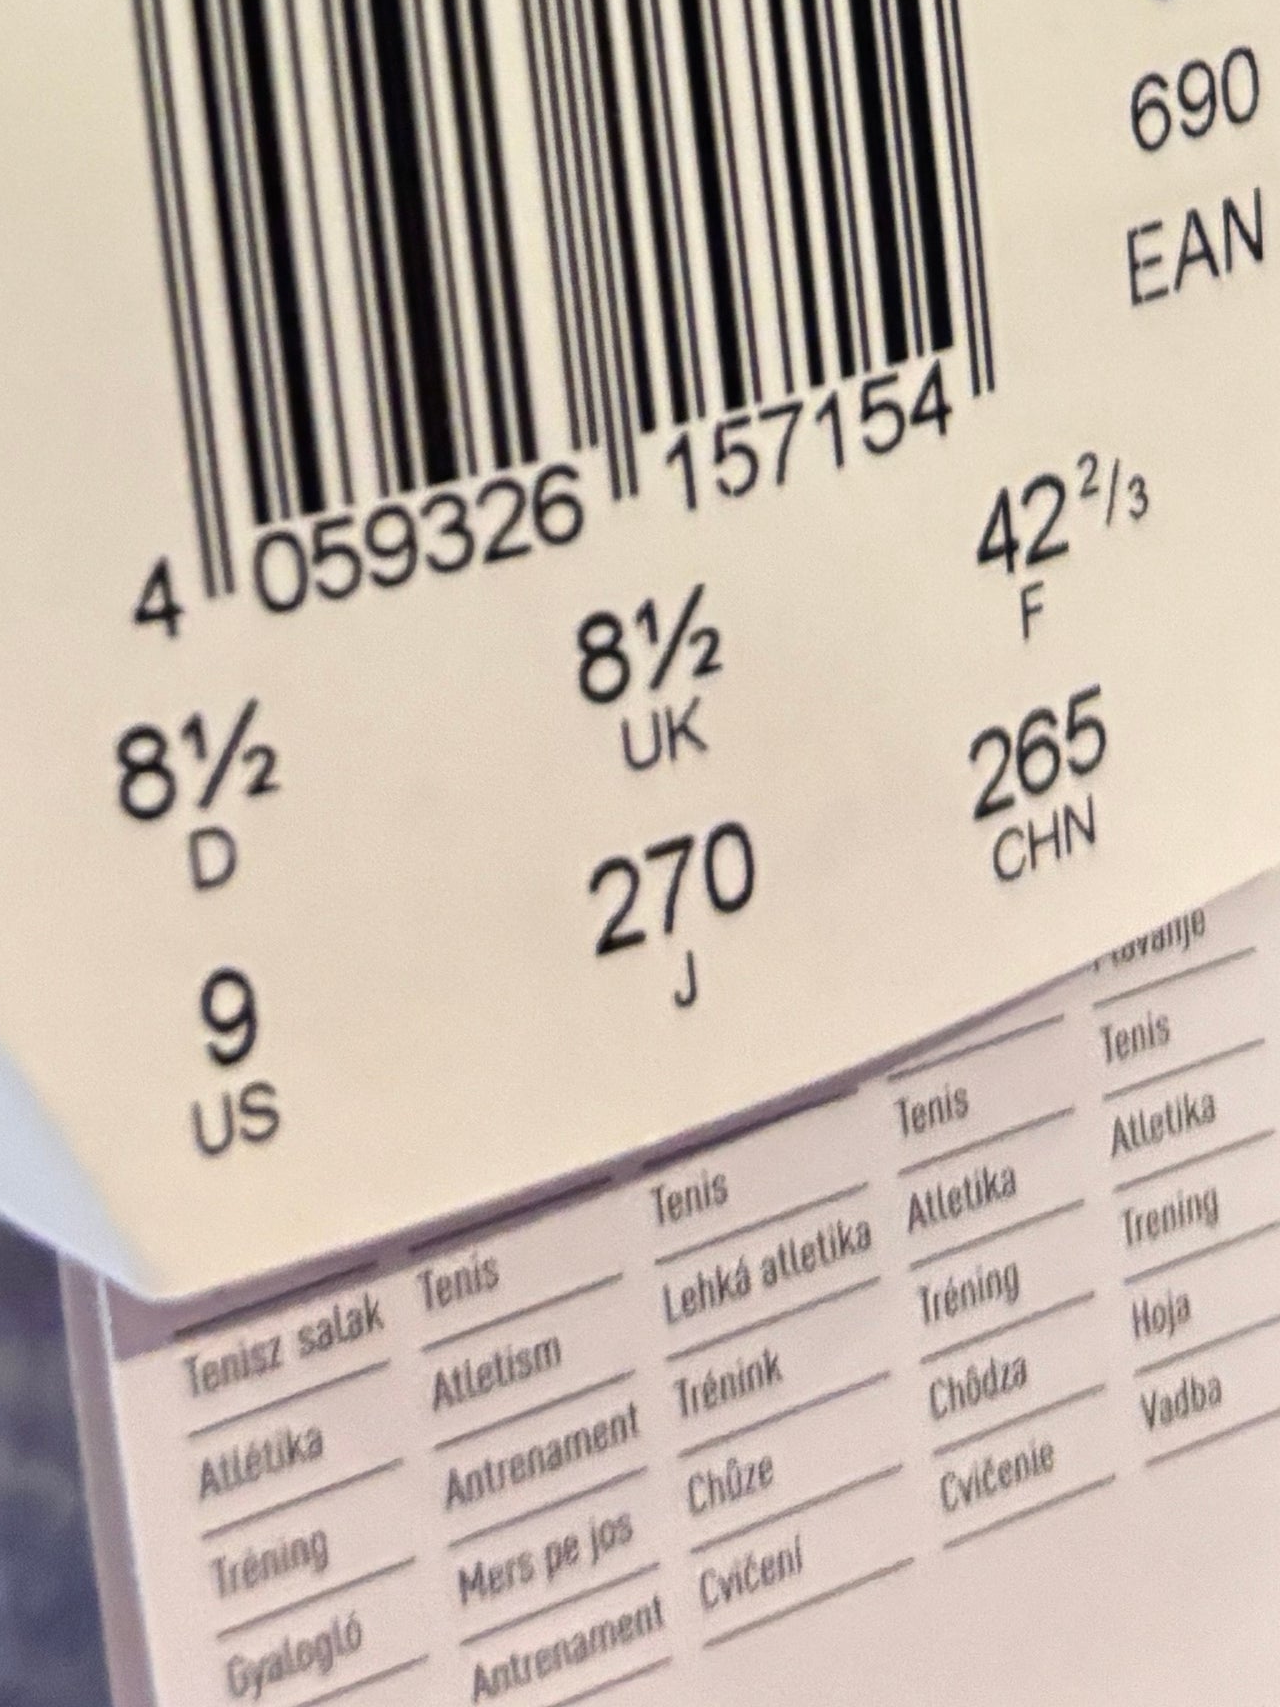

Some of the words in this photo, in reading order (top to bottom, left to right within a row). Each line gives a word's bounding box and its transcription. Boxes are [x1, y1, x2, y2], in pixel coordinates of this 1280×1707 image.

[1129, 46, 1261, 154] 690
[1126, 186, 1265, 307] EAN
[133, 558, 184, 638] 4
[251, 463, 586, 616] 059326
[664, 359, 953, 511] 157154
[1019, 580, 1045, 641] F
[620, 696, 709, 773] UK
[968, 683, 1108, 822] 265
[188, 825, 238, 893] D
[992, 791, 1097, 883] CHN
[588, 821, 756, 959] 270
[673, 951, 699, 1010] J
[200, 967, 259, 1069] 9
[1101, 1011, 1171, 1066] Tenis
[191, 1080, 281, 1158] US
[895, 1083, 970, 1138] Tenis
[1111, 1088, 1216, 1159] Atletika
[652, 1170, 728, 1227] Tenis
[906, 1165, 1017, 1234] Atletika
[1122, 1185, 1220, 1248] Trening
[418, 1249, 500, 1311] Tenis
[661, 1256, 752, 1326] Lehká
[760, 1217, 873, 1287] atletika
[919, 1260, 1021, 1326] Tréning
[1132, 1287, 1192, 1341] Hoja
[183, 1332, 282, 1398] Tenisz
[431, 1335, 562, 1412] Atletism
[674, 1348, 784, 1418] Trénink
[1140, 1372, 1223, 1430] Vadba
[444, 1400, 640, 1512] Antrenament
[211, 1529, 330, 1599] Tréning
[457, 1550, 535, 1607] Mers
[544, 1529, 580, 1583] pe
[589, 1511, 634, 1566] jos
[471, 1593, 665, 1703] Antrenament
